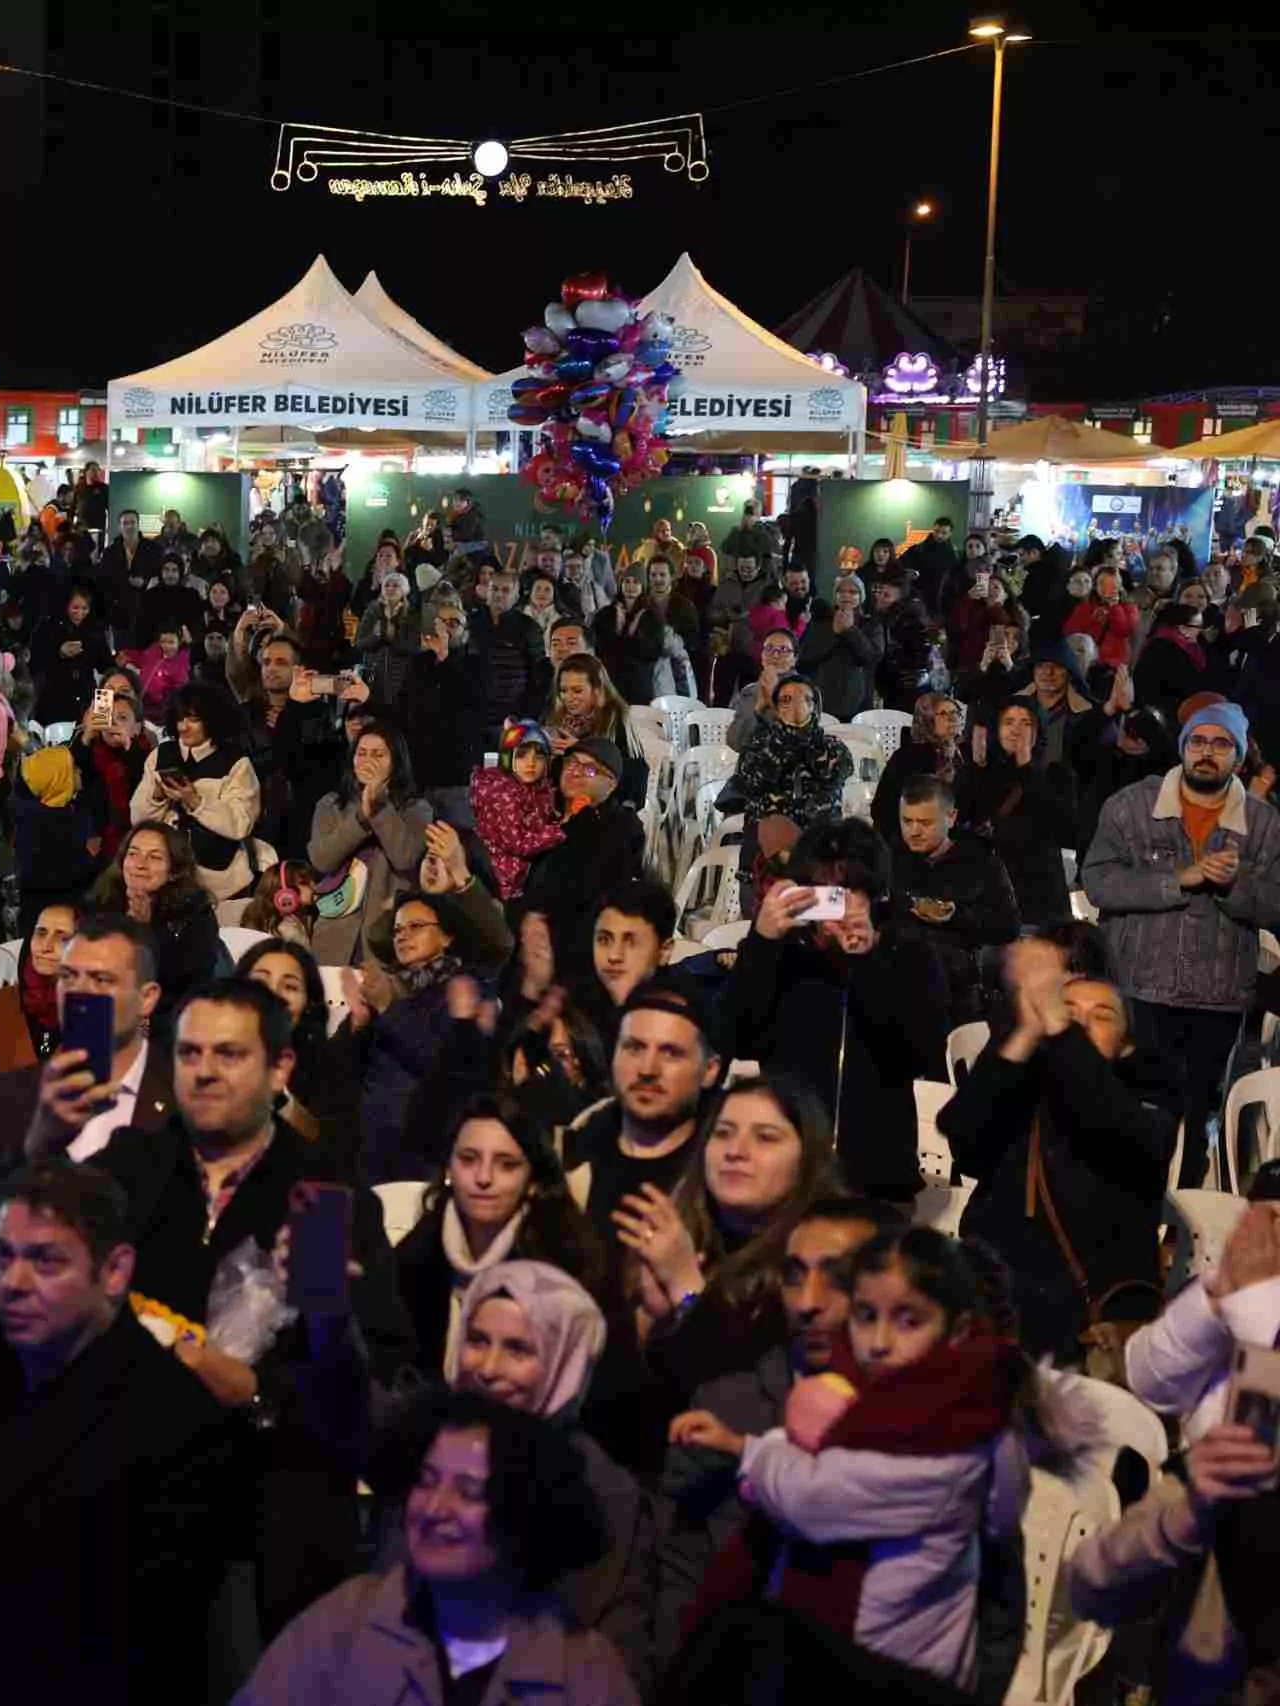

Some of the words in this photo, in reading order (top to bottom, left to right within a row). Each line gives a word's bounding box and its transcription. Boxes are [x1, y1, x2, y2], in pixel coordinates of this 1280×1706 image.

[170, 392, 266, 416] NİLÜFER
[273, 392, 409, 417] BELEDİYESİ
[666, 394, 792, 418] ELEDİYESİ
